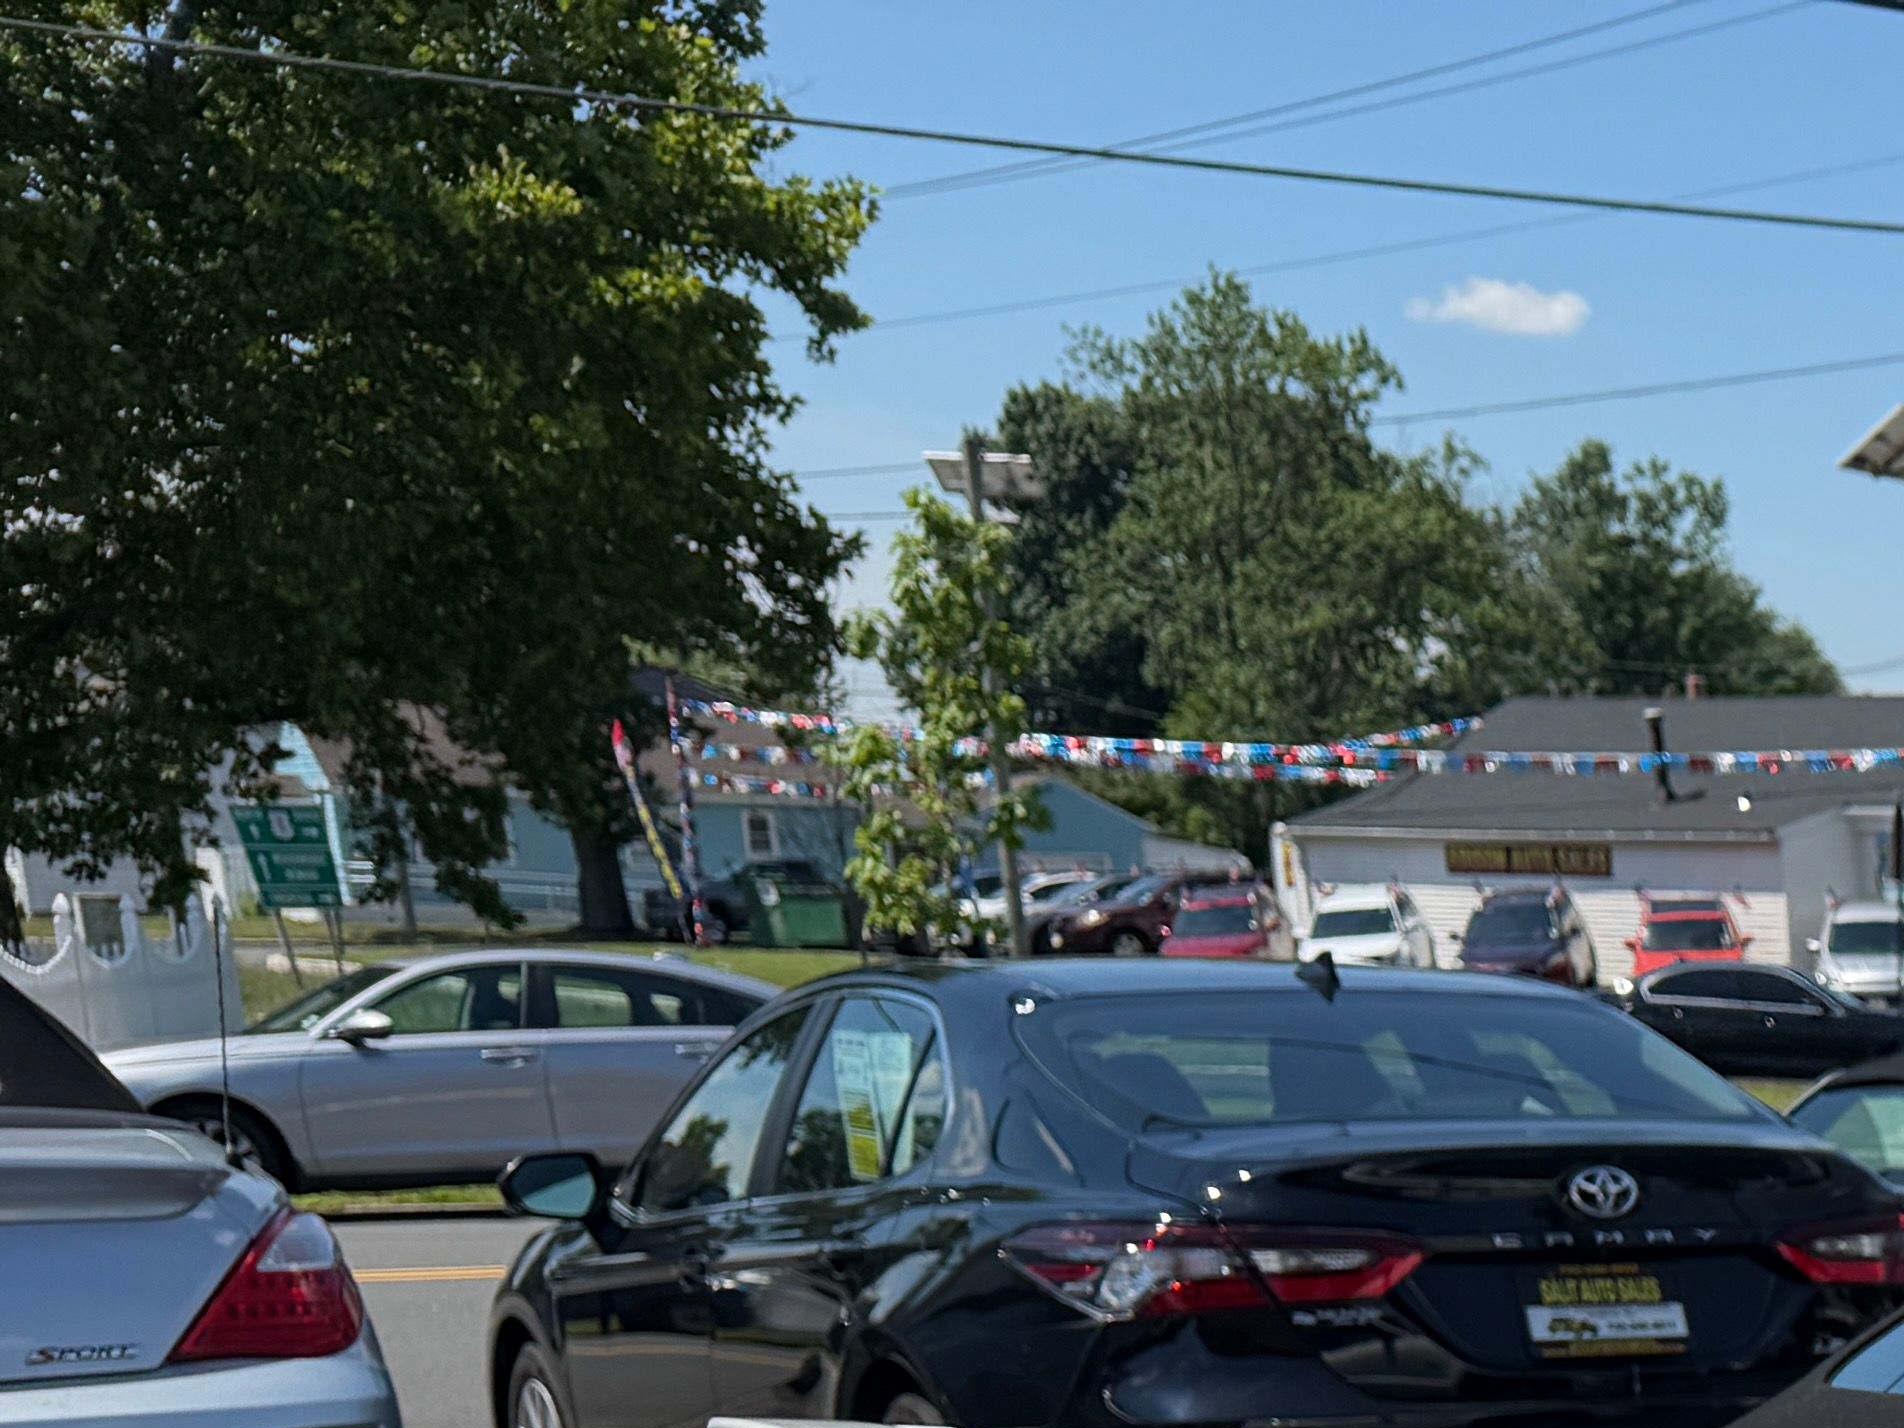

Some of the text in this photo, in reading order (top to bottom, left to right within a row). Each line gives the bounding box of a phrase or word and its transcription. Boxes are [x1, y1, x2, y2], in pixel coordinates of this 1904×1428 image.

[1491, 1227, 1719, 1249] CAMRY
[1580, 1278, 1617, 1303] AUTO
[1617, 1276, 1663, 1302] SALES
[25, 1344, 140, 1366] SPORT
